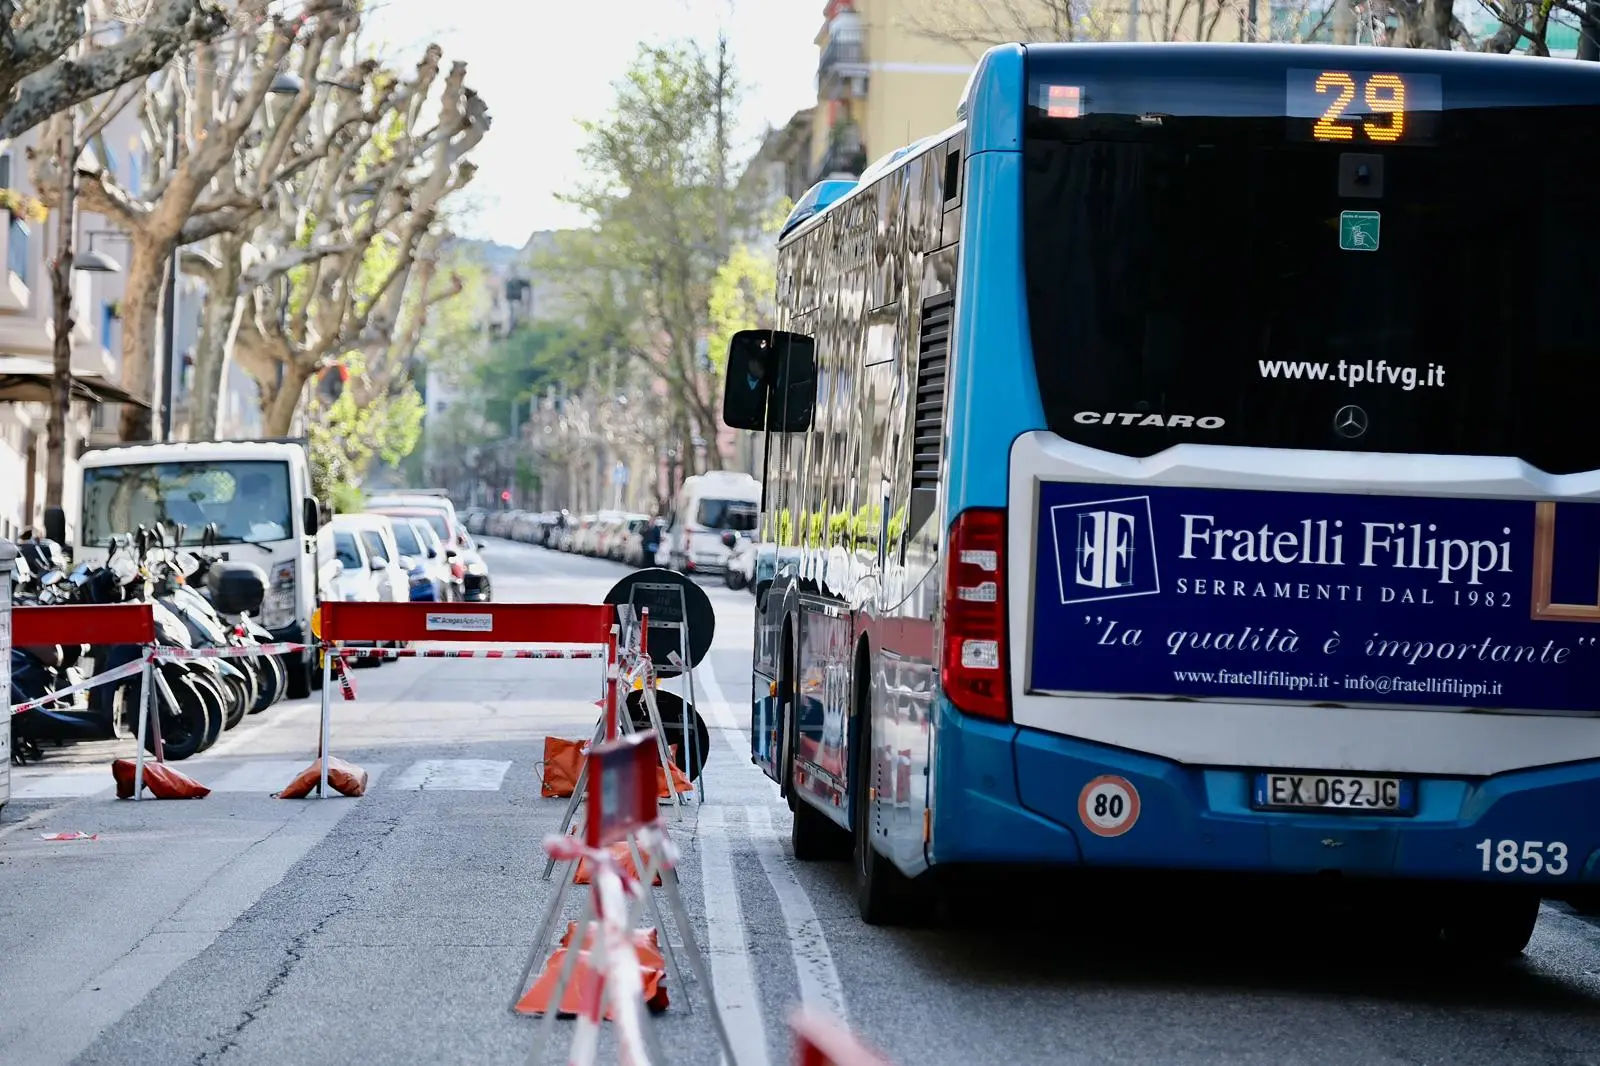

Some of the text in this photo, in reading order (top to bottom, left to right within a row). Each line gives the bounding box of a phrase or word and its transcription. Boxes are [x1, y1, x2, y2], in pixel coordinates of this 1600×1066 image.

[1313, 72, 1405, 141] 29
[1258, 360, 1446, 391] www.tplfvg.it
[1073, 411, 1226, 430] CITARO
[1179, 513, 1513, 586] Fratelli Filippi
[1177, 577, 1511, 608] SERRAMENTI DAL 1982
[1166, 627, 1299, 655] qualità
[1323, 631, 1340, 654] è
[1174, 669, 1329, 691] www.fratellifilippi.it
[1344, 674, 1503, 698] info@fratellifilippi.it
[1094, 787, 1124, 818] 80
[1272, 777, 1397, 807] EX 062JG
[1476, 839, 1569, 875] 1853
